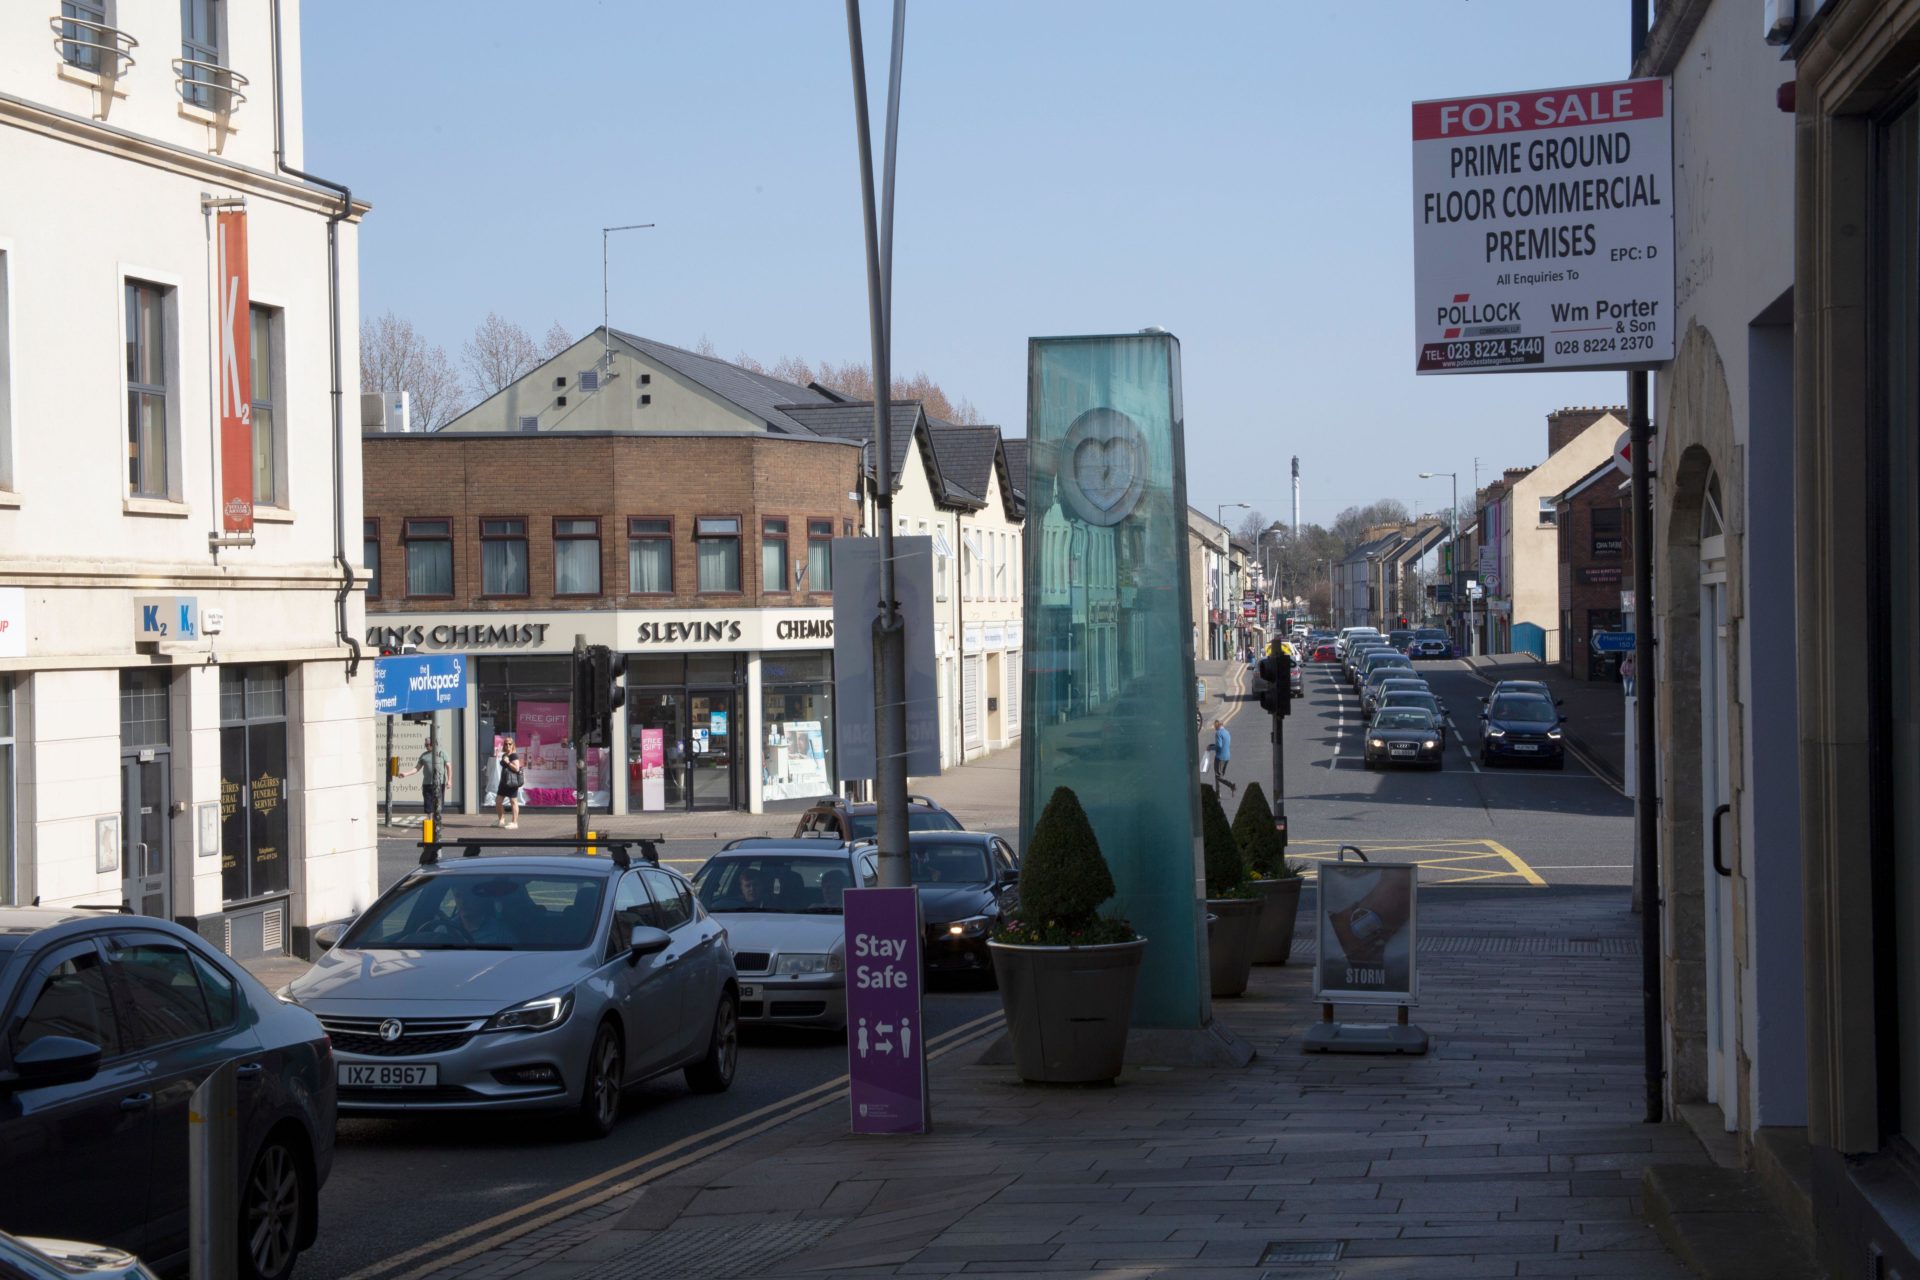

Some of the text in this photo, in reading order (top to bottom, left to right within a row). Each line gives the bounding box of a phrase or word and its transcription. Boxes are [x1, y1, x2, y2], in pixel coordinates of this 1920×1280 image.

[1440, 88, 1633, 134] FOR SALE
[1450, 132, 1630, 178] PRIME GROUND
[1424, 174, 1660, 224] FLOOR COMMERCIAL
[1486, 224, 1596, 263] PREMISES
[1610, 245, 1658, 262] EPC: D
[1496, 269, 1579, 286] All Enquiries To
[1437, 301, 1521, 325] POLLOCK
[1551, 299, 1659, 323] Wm Porter
[1615, 319, 1656, 334] & Son
[1425, 338, 1542, 361] TEL: 028 8224 5440
[1555, 336, 1654, 354] 028 8224 2370
[431, 623, 550, 644] CHEMIST
[638, 620, 742, 643] SLEVIN'S
[419, 664, 427, 674] the
[409, 664, 460, 702] workspace
[520, 714, 567, 722] FREE GIFT
[251, 778, 279, 790] MAGUIRES
[253, 788, 278, 800] FUNERAL
[254, 798, 277, 809] SERVICE
[855, 933, 907, 961] Stay
[856, 965, 908, 989] Safe
[1346, 968, 1385, 985] STORM
[348, 1066, 426, 1084] IXZ 8967
